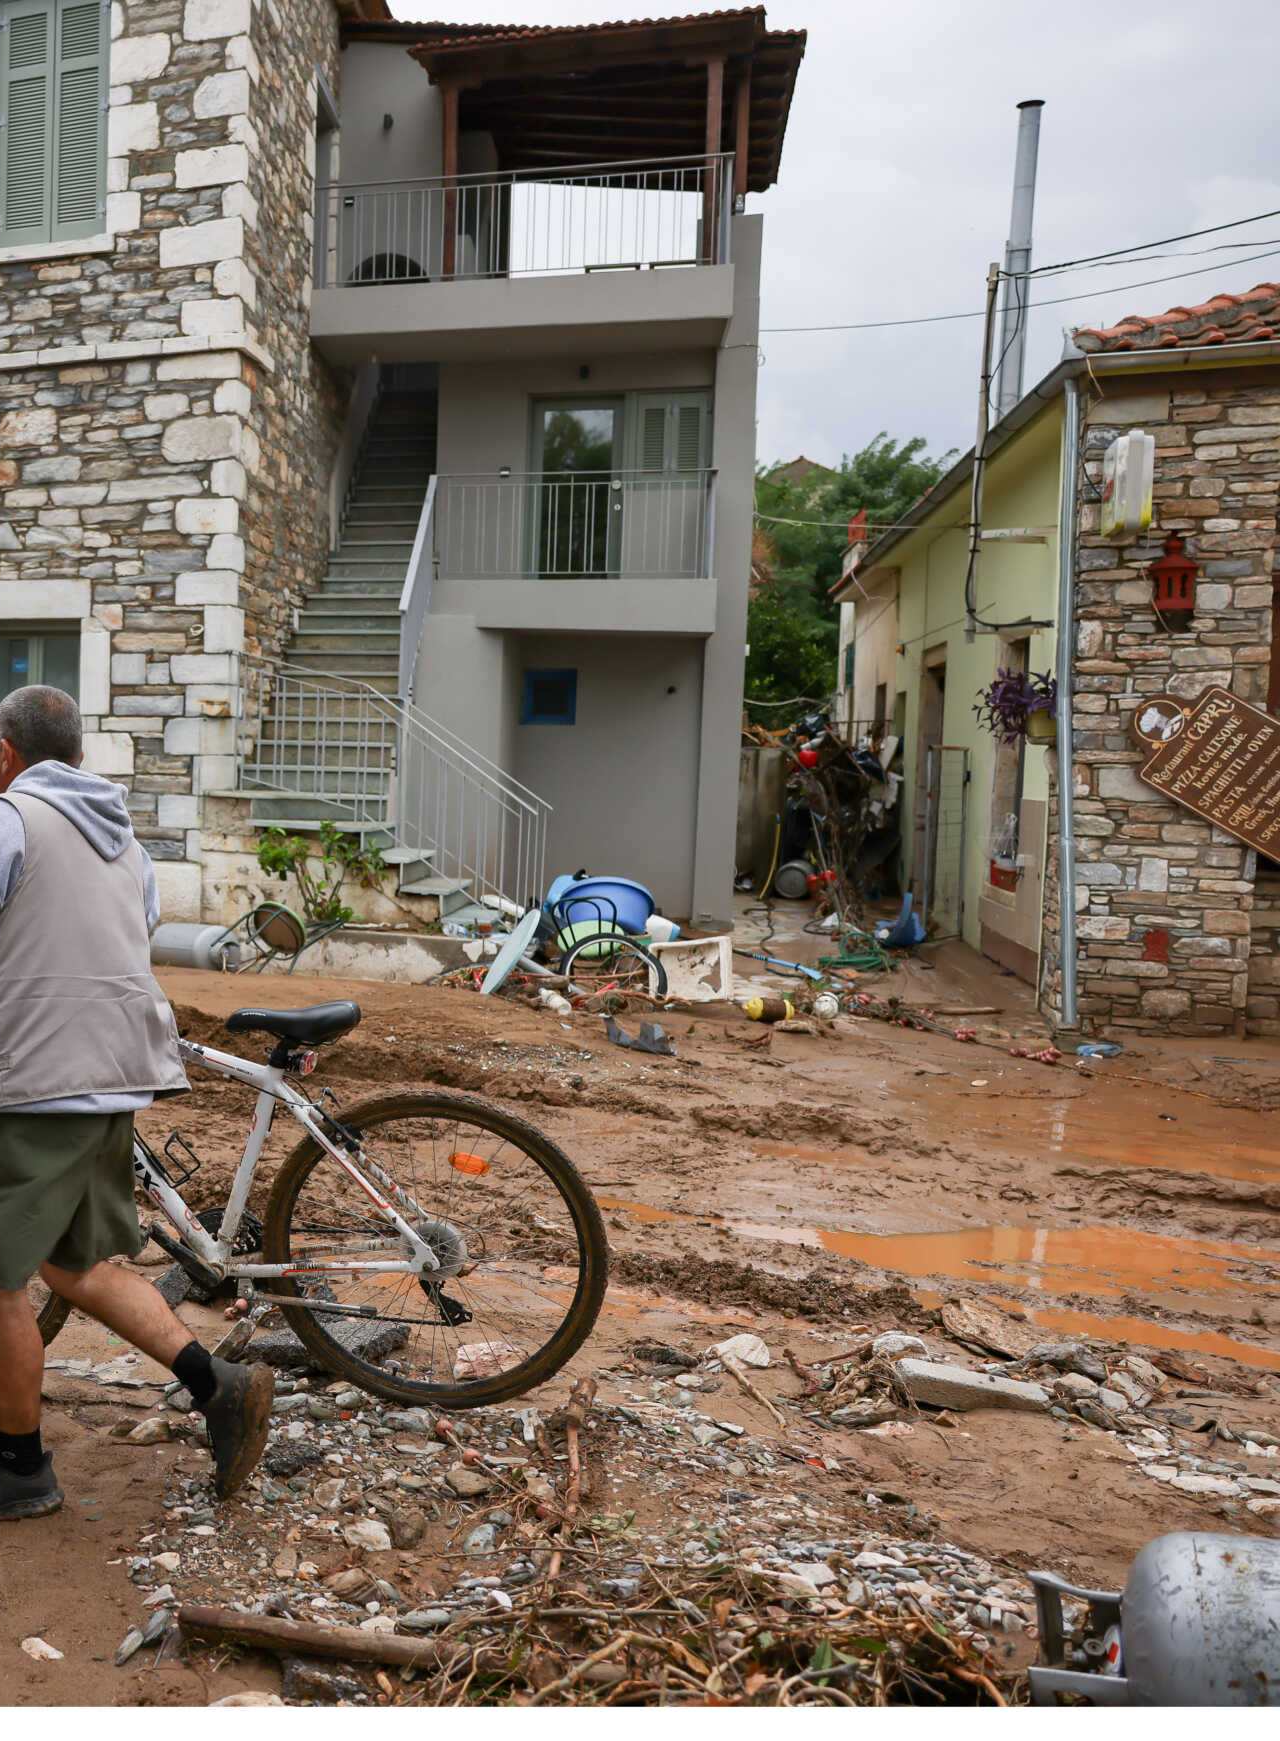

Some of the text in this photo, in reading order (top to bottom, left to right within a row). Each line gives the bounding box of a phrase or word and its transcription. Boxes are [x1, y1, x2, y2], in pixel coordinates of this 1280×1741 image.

[1192, 733, 1248, 789] home made
[1198, 758, 1246, 809] SPAGHETTI
[1248, 725, 1274, 752] OVEN
[1212, 786, 1247, 818] PASTA
[1228, 804, 1255, 826] GRILL
[1244, 808, 1274, 830] Greek
